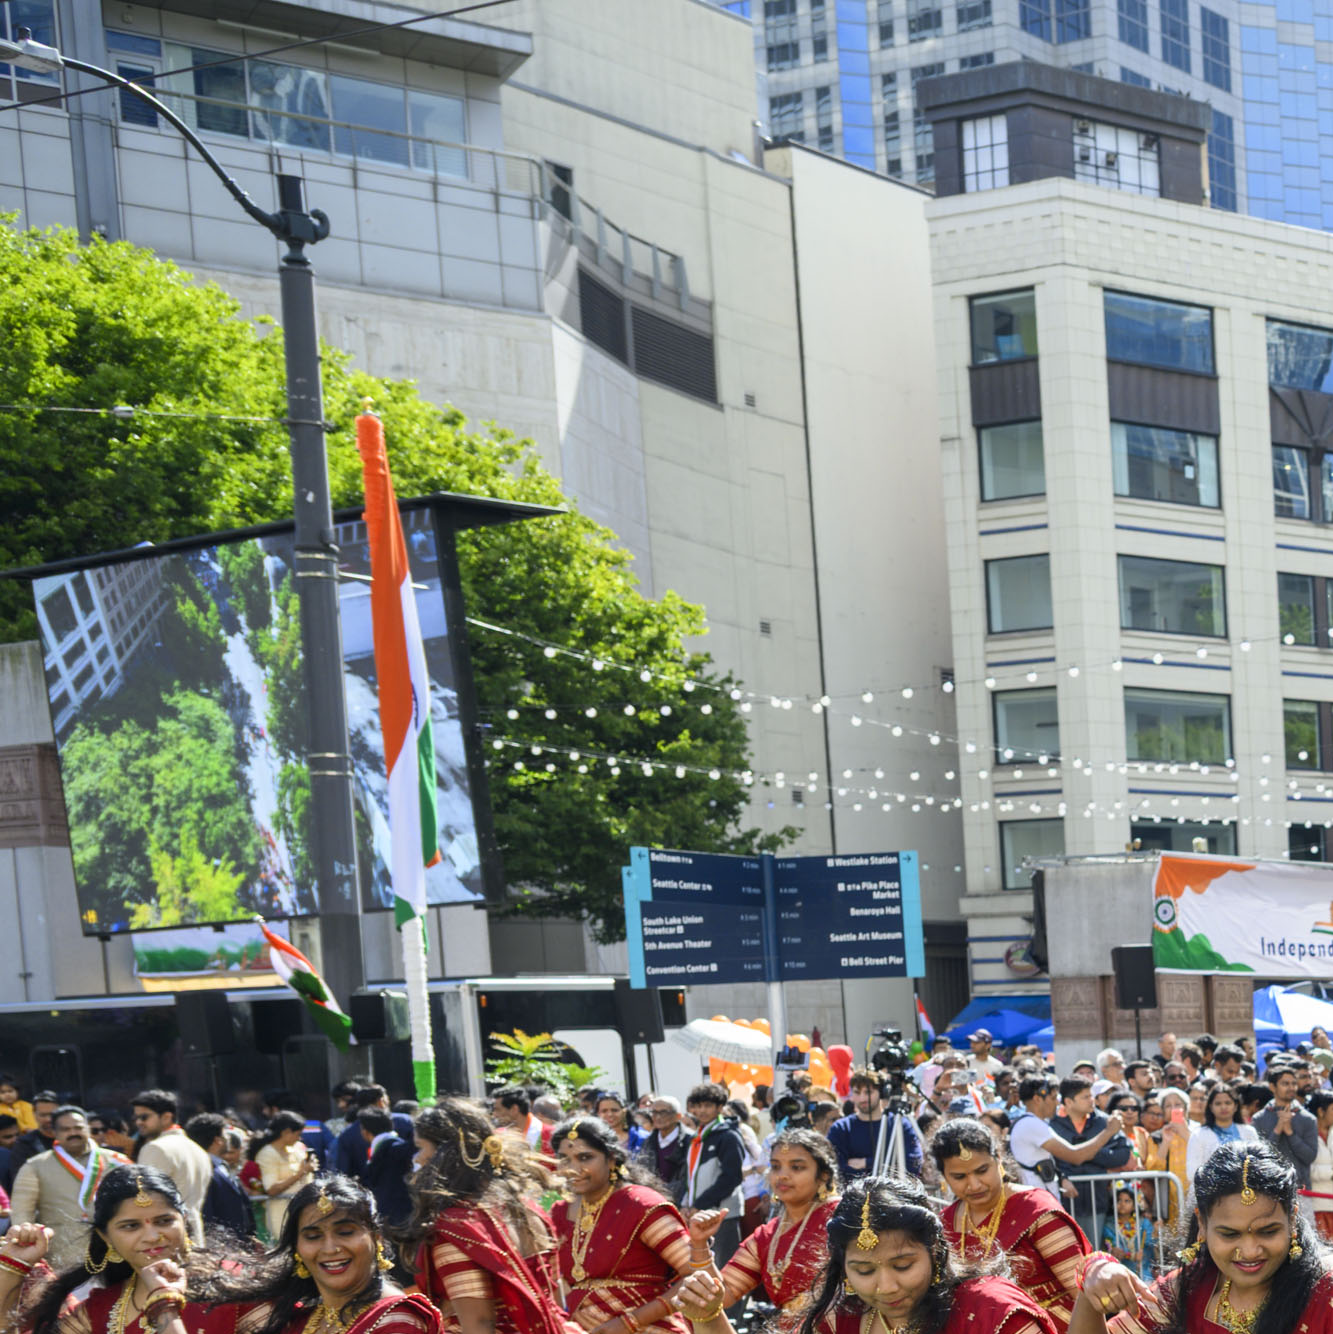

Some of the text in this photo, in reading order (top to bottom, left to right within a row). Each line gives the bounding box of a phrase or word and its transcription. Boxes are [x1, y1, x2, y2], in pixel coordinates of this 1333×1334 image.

[651, 852, 681, 864] Belltown
[835, 855, 898, 867] Westlake Station
[653, 879, 700, 890] Seattle Center
[861, 880, 899, 890] Pike Place
[872, 891, 900, 899] Market
[850, 905, 901, 917] Benaroya Hall
[643, 915, 704, 926] South Lake Union
[643, 926, 676, 935] Streetcar
[830, 931, 902, 942] Seattle Art Museum
[645, 940, 712, 950] 5th Avenue Theater
[849, 955, 904, 966] Bell Street Pier
[646, 963, 709, 975] Convention Center
